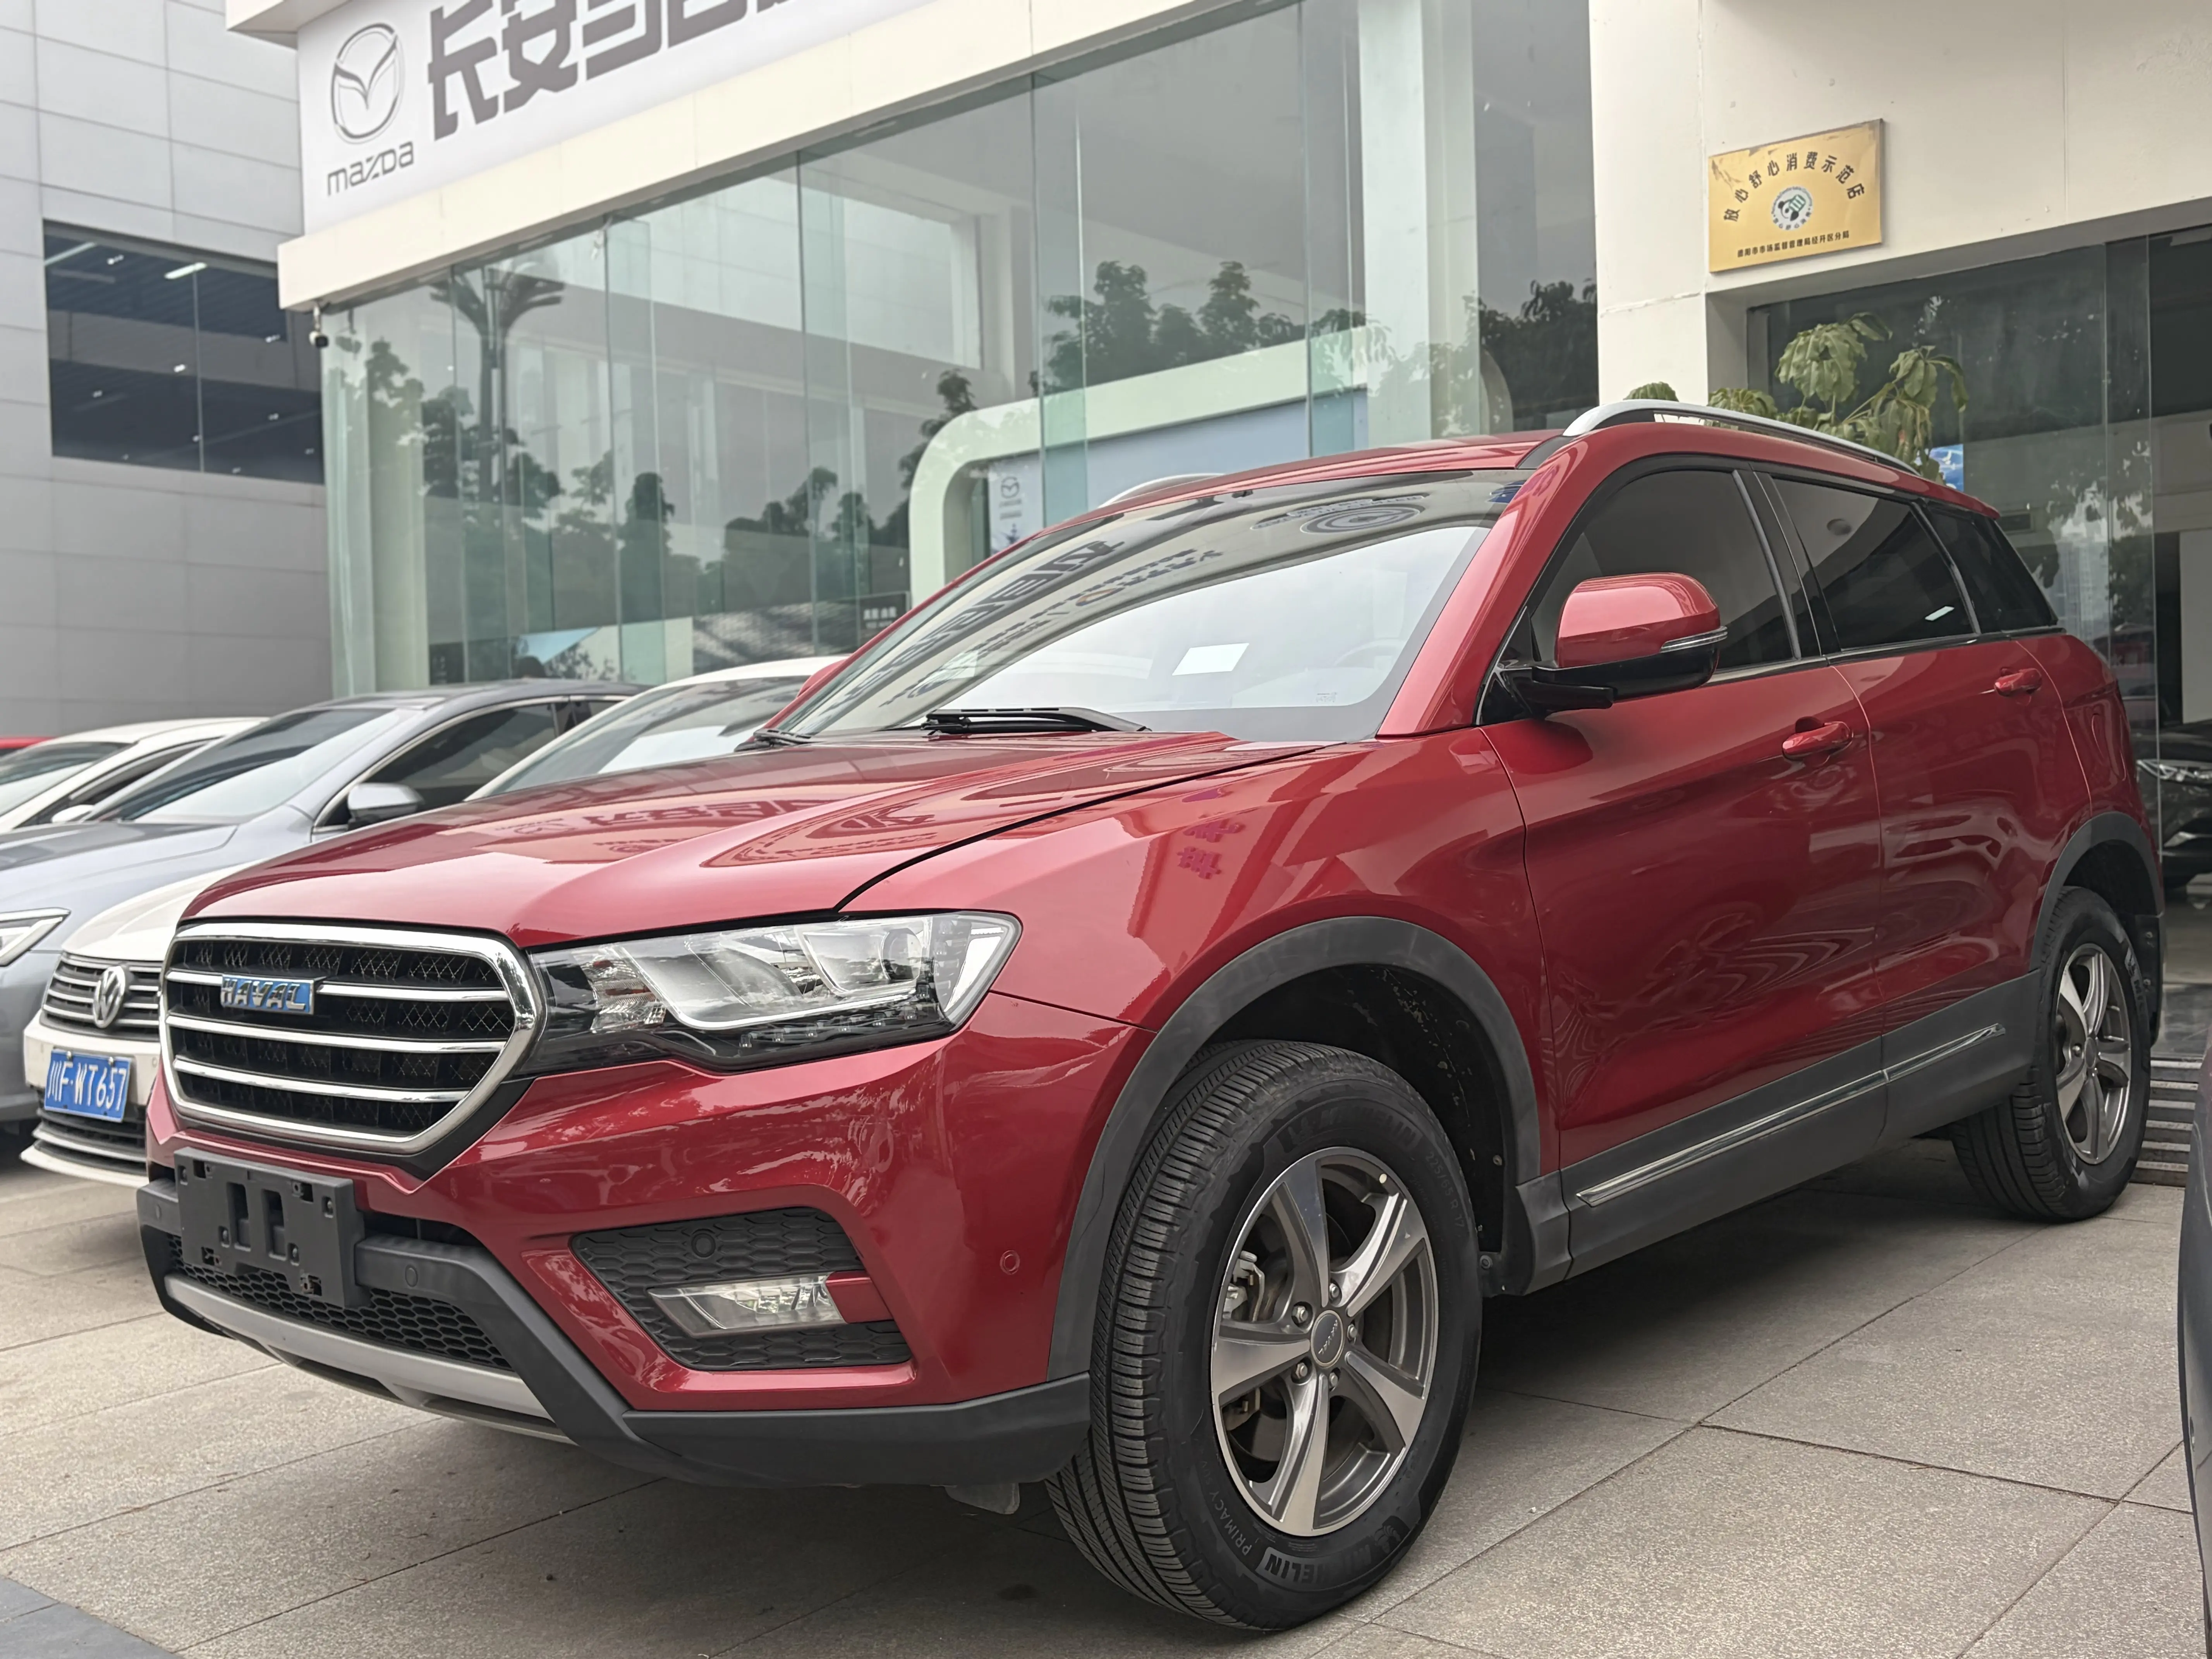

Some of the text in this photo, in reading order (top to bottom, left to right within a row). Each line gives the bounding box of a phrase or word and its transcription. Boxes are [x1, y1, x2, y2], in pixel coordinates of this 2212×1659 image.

[327, 141, 414, 196] mazda
[1723, 151, 1865, 222] 放心舒心消费示范店
[220, 978, 306, 1010] HAVAL
[1209, 1490, 1252, 1556] PRIMACY
